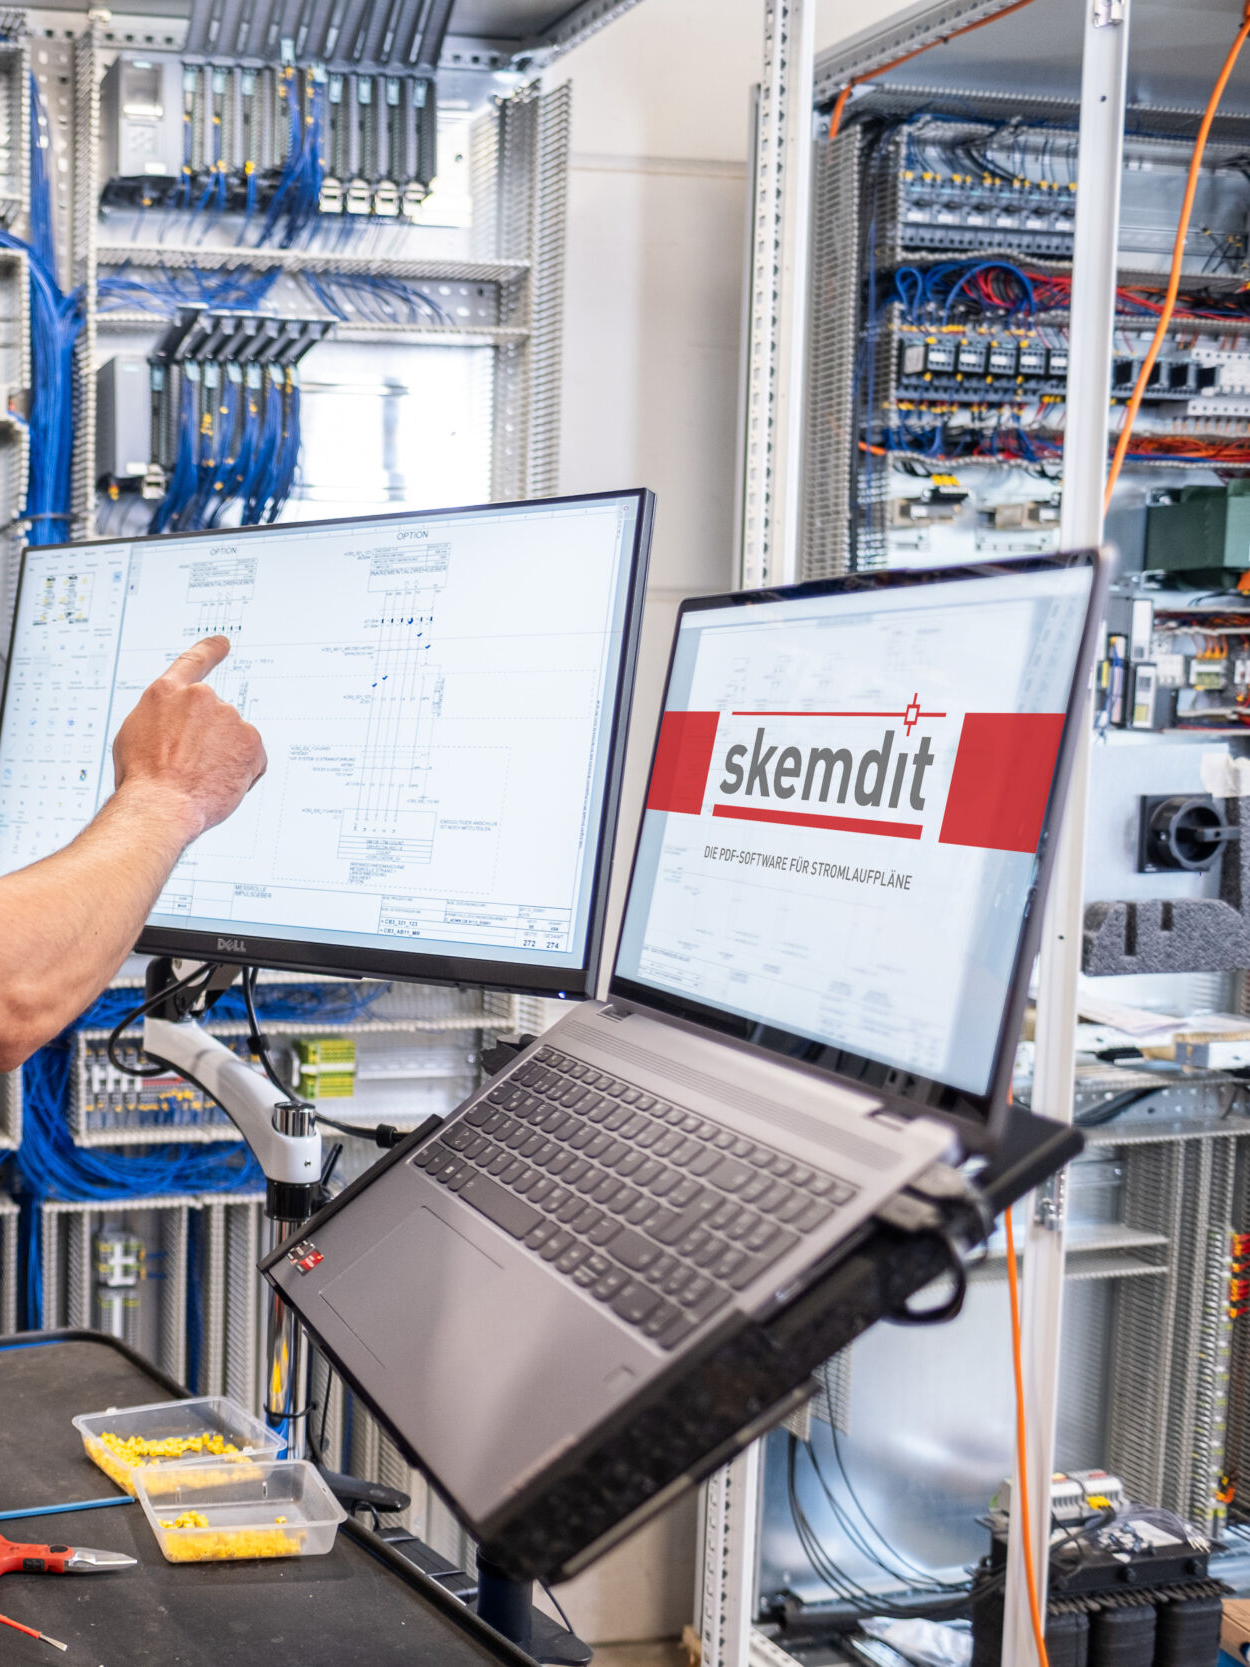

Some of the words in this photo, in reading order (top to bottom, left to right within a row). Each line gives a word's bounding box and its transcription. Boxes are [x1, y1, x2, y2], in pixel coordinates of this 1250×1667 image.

[397, 530, 429, 540] OPTION
[210, 547, 238, 556] OPTION
[719, 727, 935, 811] skemdit
[704, 845, 718, 860] DIE
[719, 847, 788, 871] PDF-SOFTWARE
[789, 856, 810, 874] FÜR
[810, 861, 913, 890] STROMLAUFPLÄNE
[217, 938, 246, 953] DELL
[523, 939, 536, 948] 272
[546, 941, 559, 950] 274
